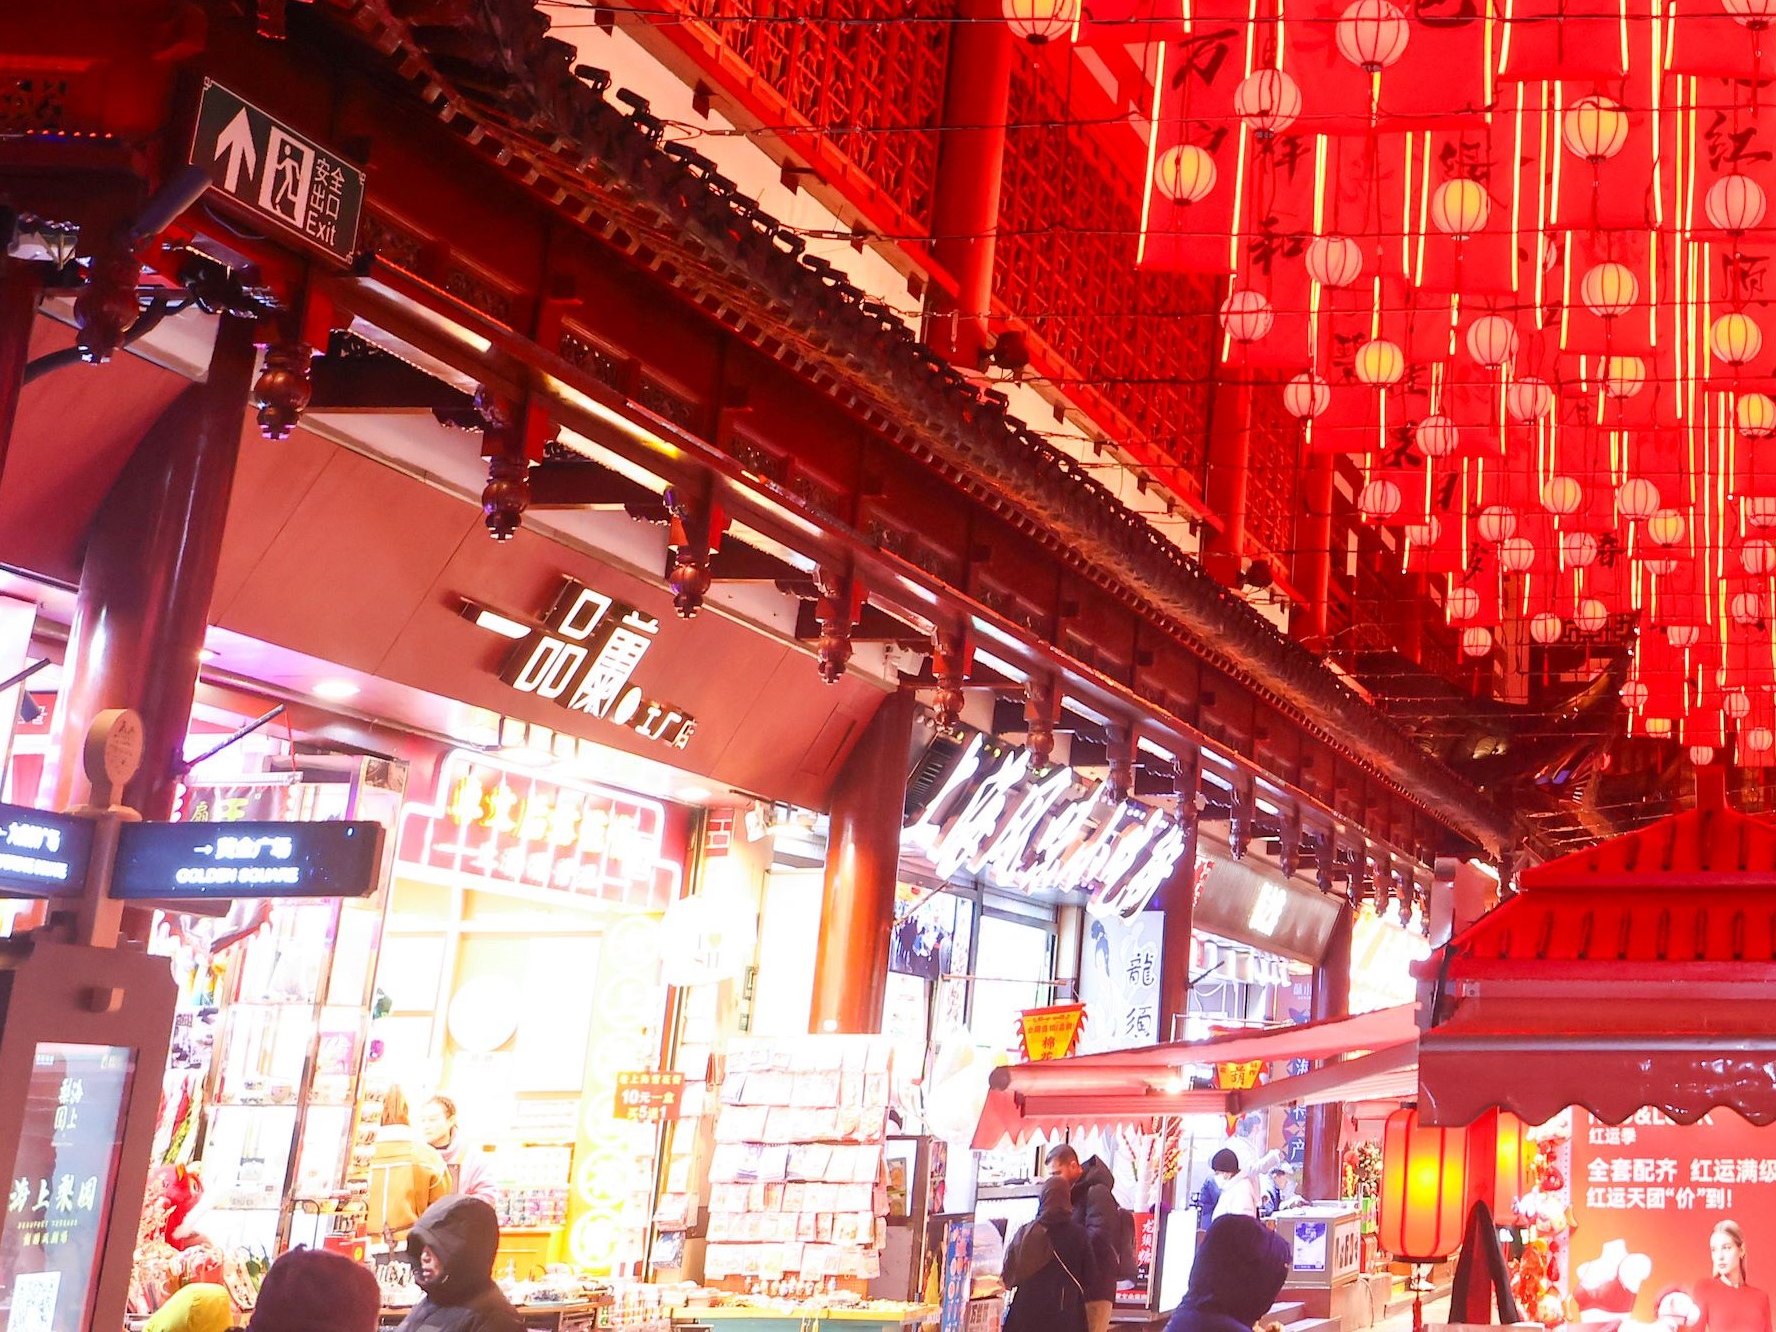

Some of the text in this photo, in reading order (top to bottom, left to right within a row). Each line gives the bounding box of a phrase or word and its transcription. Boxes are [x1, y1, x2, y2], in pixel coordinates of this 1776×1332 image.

[314, 157, 346, 196] 安全
[309, 185, 341, 221] 出口
[305, 210, 338, 247] Exit
[1588, 1127, 1637, 1145] 红运季
[1587, 1157, 1678, 1182] 全套配齐
